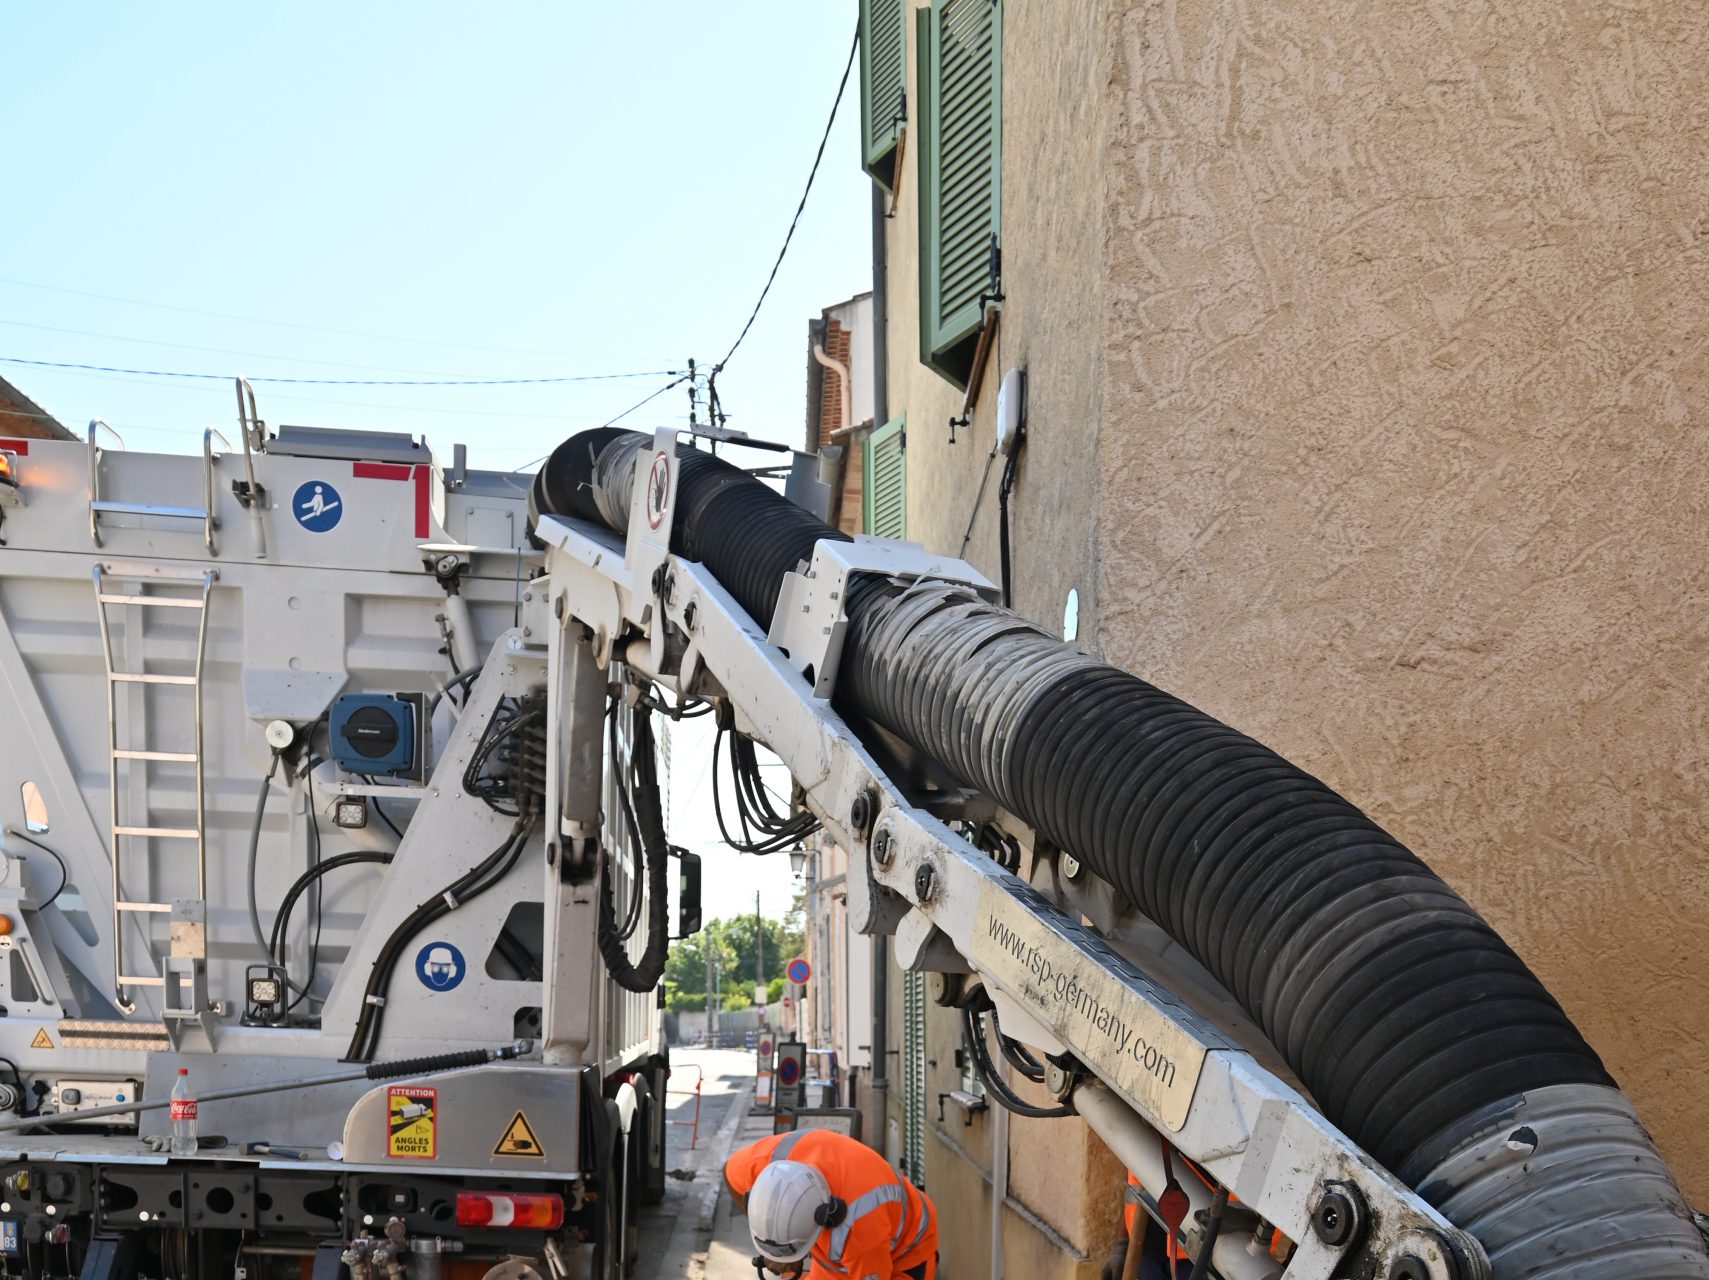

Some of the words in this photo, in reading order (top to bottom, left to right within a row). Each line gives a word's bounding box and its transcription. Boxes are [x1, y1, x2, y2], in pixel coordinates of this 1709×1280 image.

[988, 915, 1176, 1088] www.rsp-germany.com
[391, 1088, 434, 1097] ATTENTION
[395, 1137, 429, 1145] ANGLES
[396, 1145, 428, 1153] MORTS
[4, 1236, 16, 1249] 83
